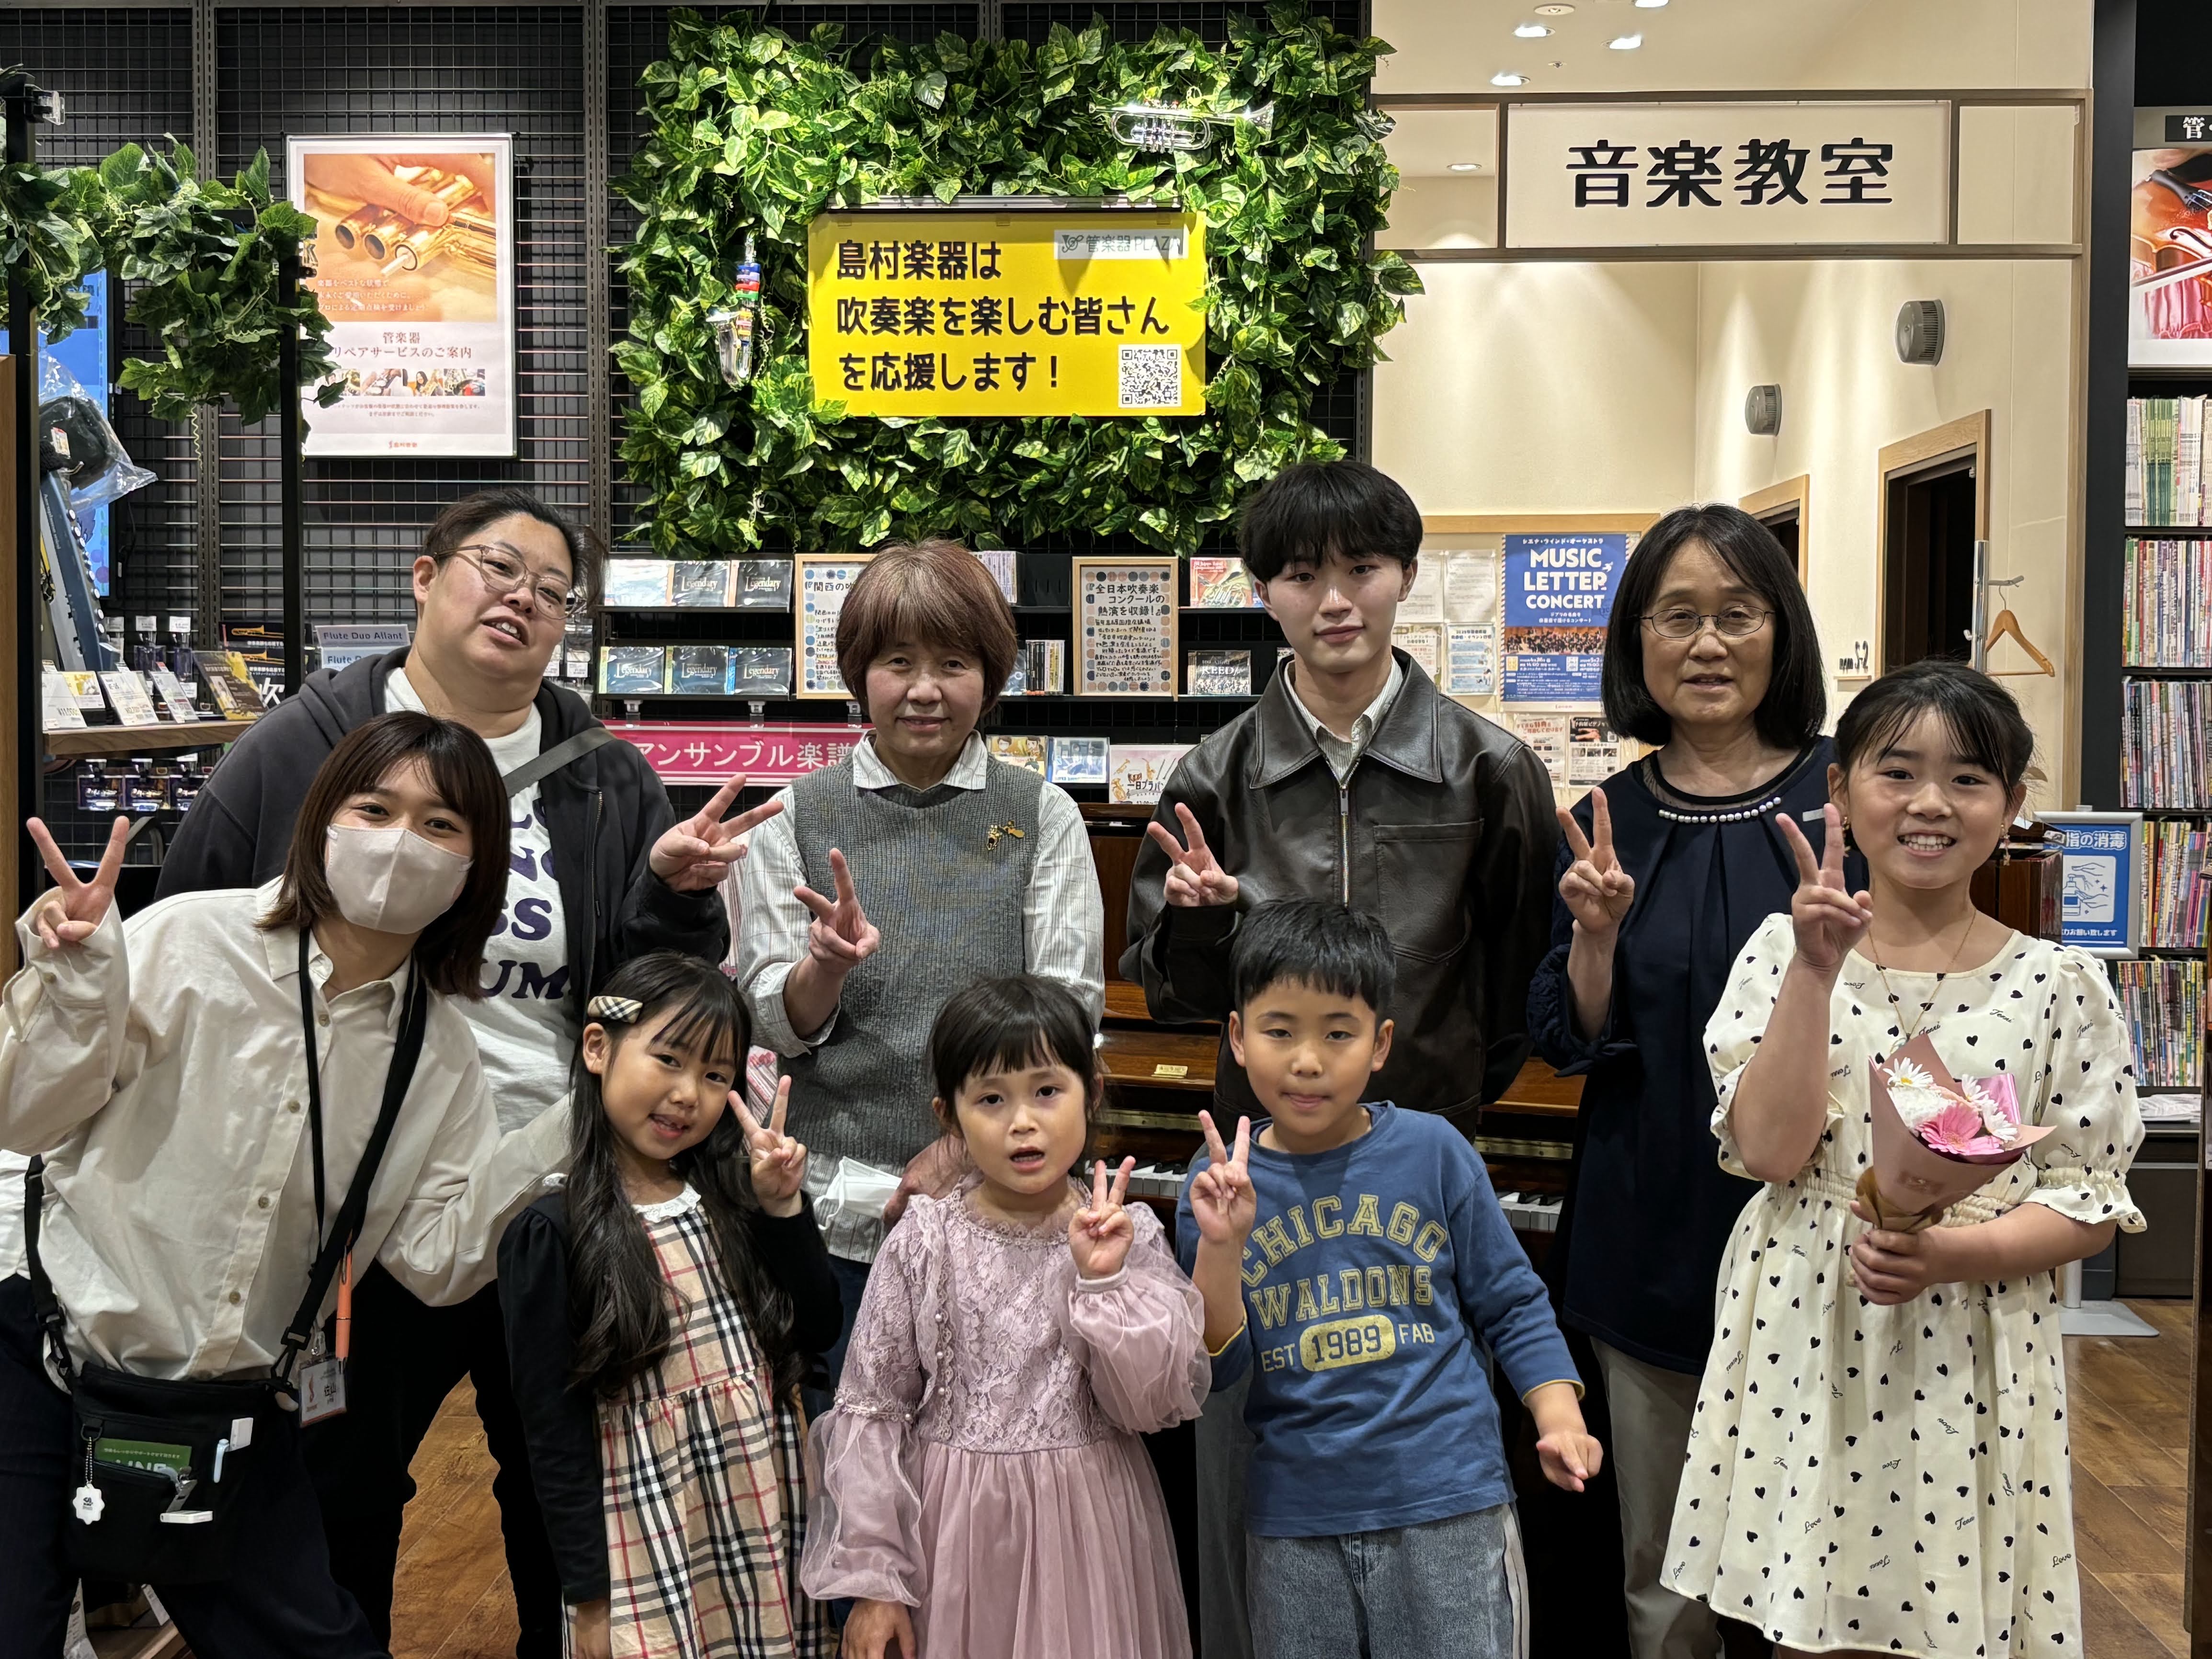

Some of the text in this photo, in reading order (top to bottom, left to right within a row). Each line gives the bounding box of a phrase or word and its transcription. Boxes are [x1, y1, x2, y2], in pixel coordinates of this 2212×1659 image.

[1566, 137, 1893, 207] 音楽教室
[1086, 234, 1130, 252] 管楽器
[837, 239, 1001, 280] 島村楽器は
[837, 296, 1169, 336] 吹奏楽を楽しむ皆さん
[383, 332, 420, 344] 管楽器
[334, 346, 472, 358] リペアサービスのご案内
[1530, 548, 1602, 568] MUSIC
[681, 576, 718, 591] Legendary
[745, 576, 781, 591] Legendary
[1524, 571, 1607, 591] LETTER
[1108, 595, 1165, 604] コンクールの
[1526, 594, 1605, 609] CONCERT
[374, 632, 403, 640] Allant
[328, 656, 353, 664] Flute
[681, 662, 717, 678] Legendary
[743, 664, 780, 679] Legendary
[2066, 831, 2127, 850] 指の消毒
[1241, 1194, 1447, 1287] CHICAGO
[1249, 1265, 1434, 1330] WALDONS
[1261, 1323, 1435, 1372] EST 1989 FAB
